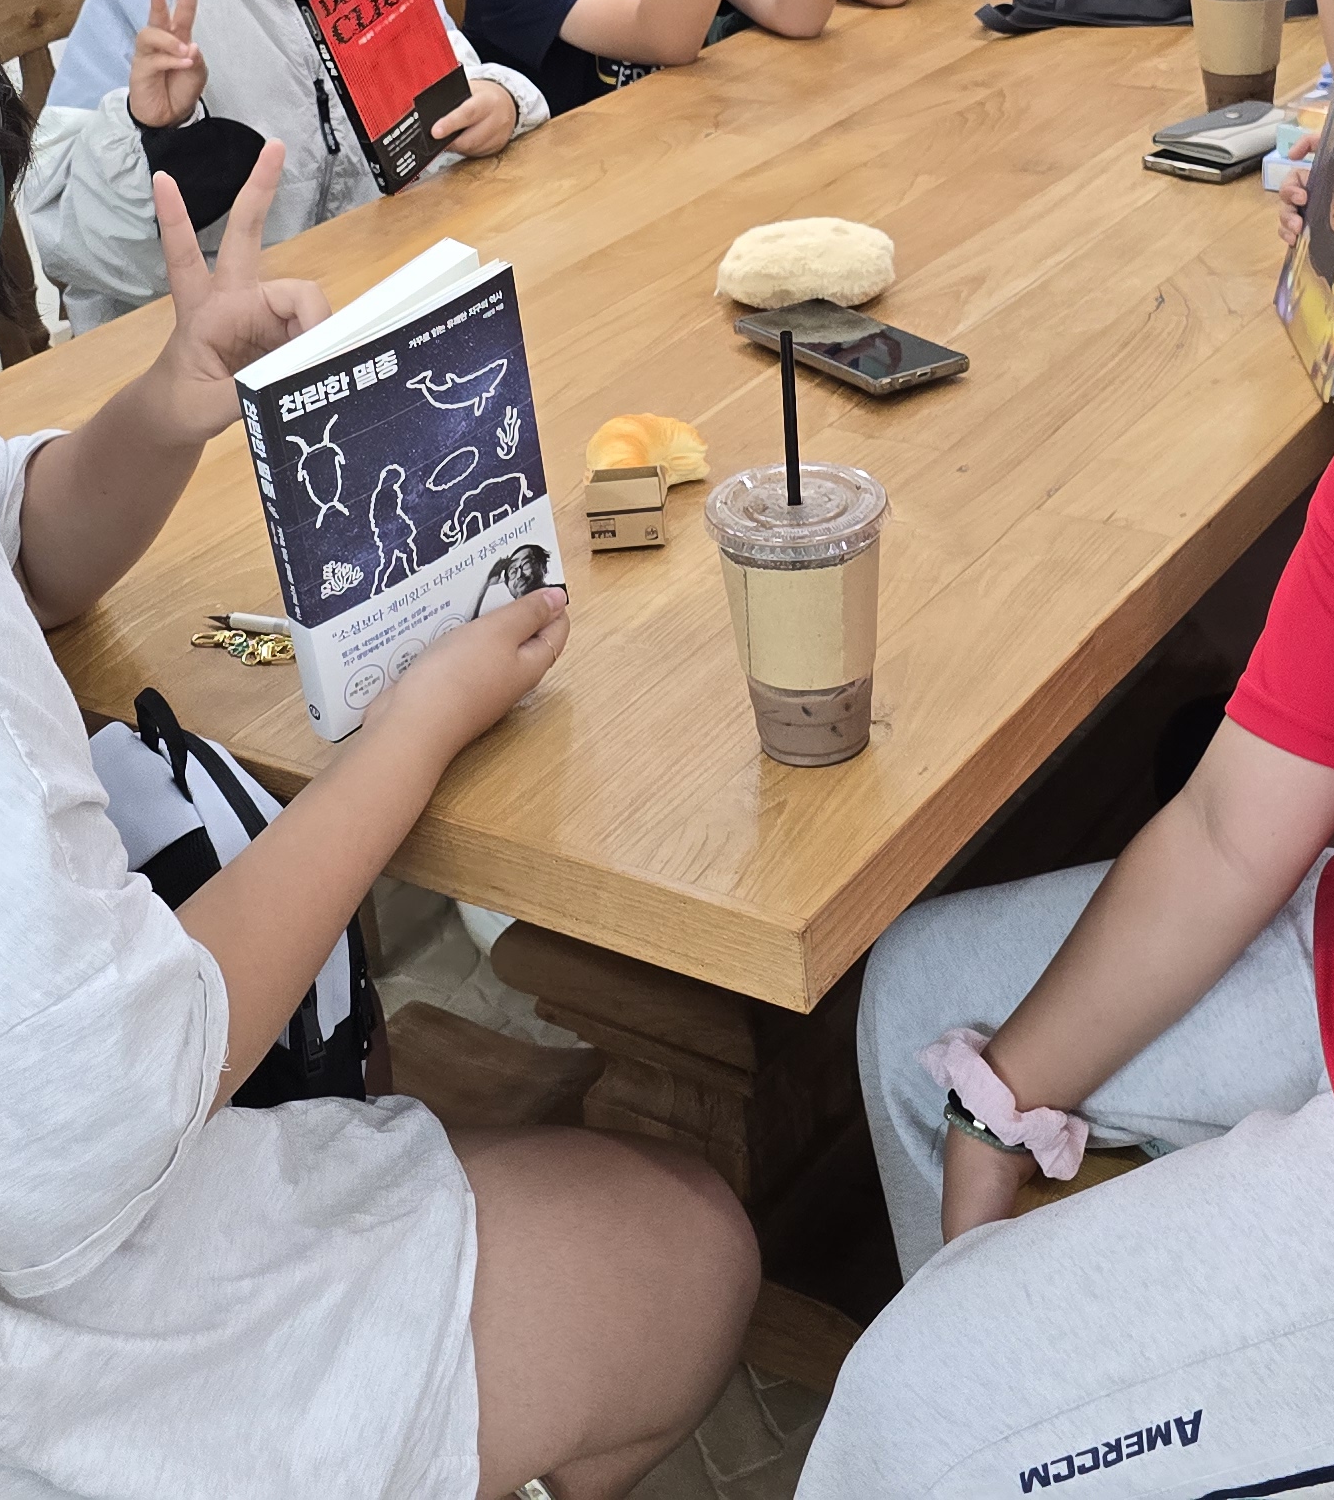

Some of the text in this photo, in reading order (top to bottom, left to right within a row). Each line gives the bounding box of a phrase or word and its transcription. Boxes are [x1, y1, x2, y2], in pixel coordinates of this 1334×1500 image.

[468, 299, 489, 317] 지구의
[278, 349, 398, 423] 찬란한 멸종
[387, 583, 431, 615] 재미있고
[433, 556, 476, 588] 다큐보다
[1019, 1409, 1203, 1493] AMERCCM
